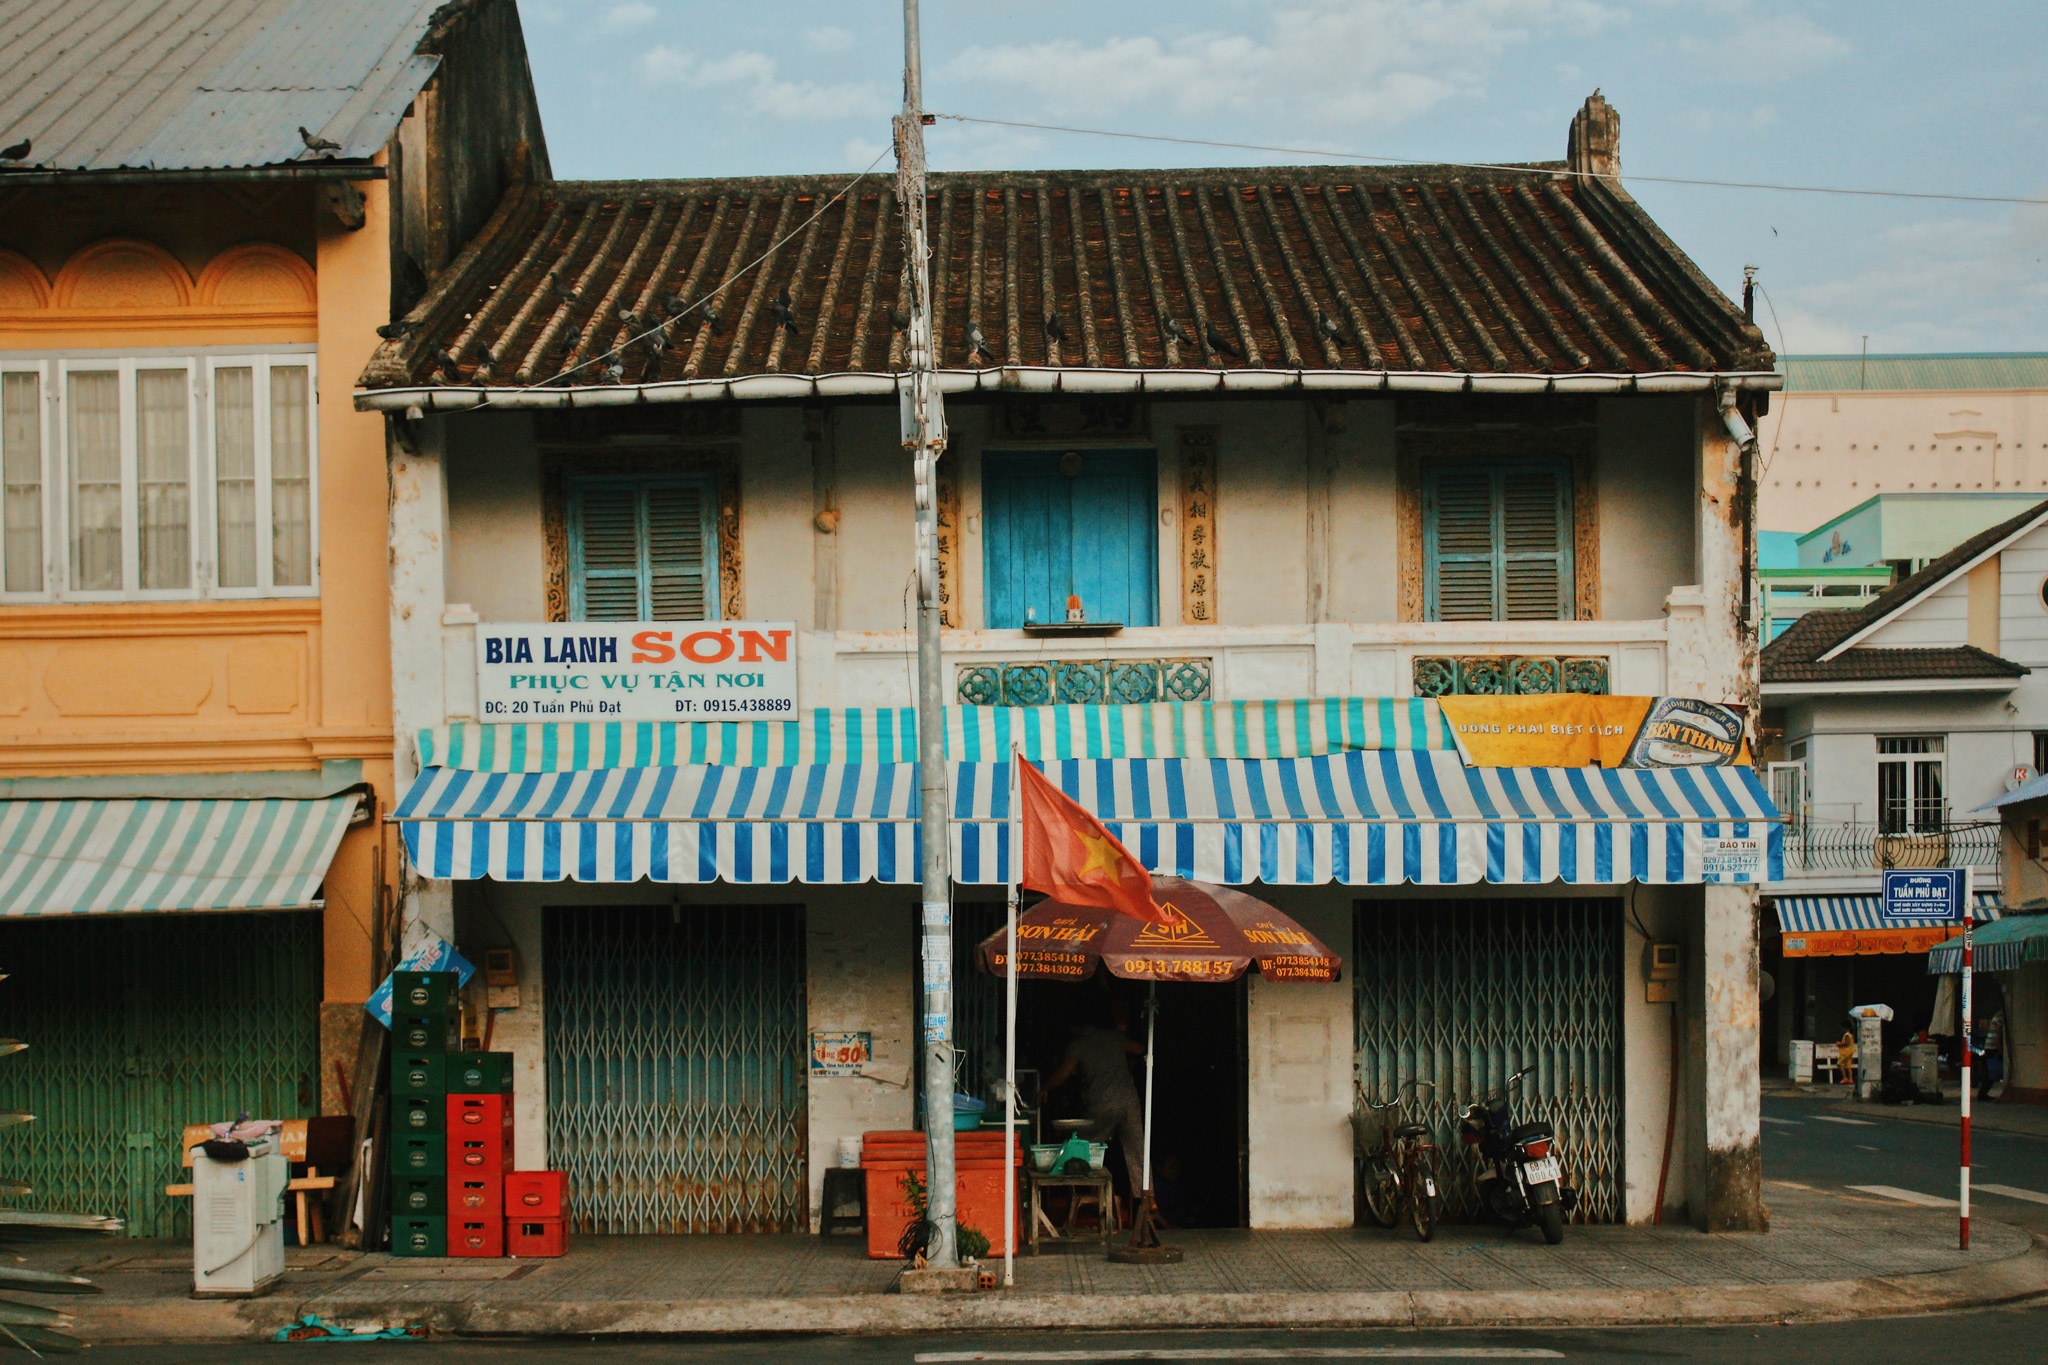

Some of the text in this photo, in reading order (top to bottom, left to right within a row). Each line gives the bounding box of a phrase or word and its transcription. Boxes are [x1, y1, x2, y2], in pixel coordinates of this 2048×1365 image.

[486, 628, 792, 669] BIA LẠNH SƠN
[509, 670, 765, 694] PHỤC VỤ TẬN NƠI
[485, 698, 622, 716] ĐC: 20 Tuần Phủ Đạt
[675, 698, 792, 712] ĐT: 0915.438889
[1052, 923, 1099, 941] HẢI
[1124, 960, 1233, 975] 0913.788157
